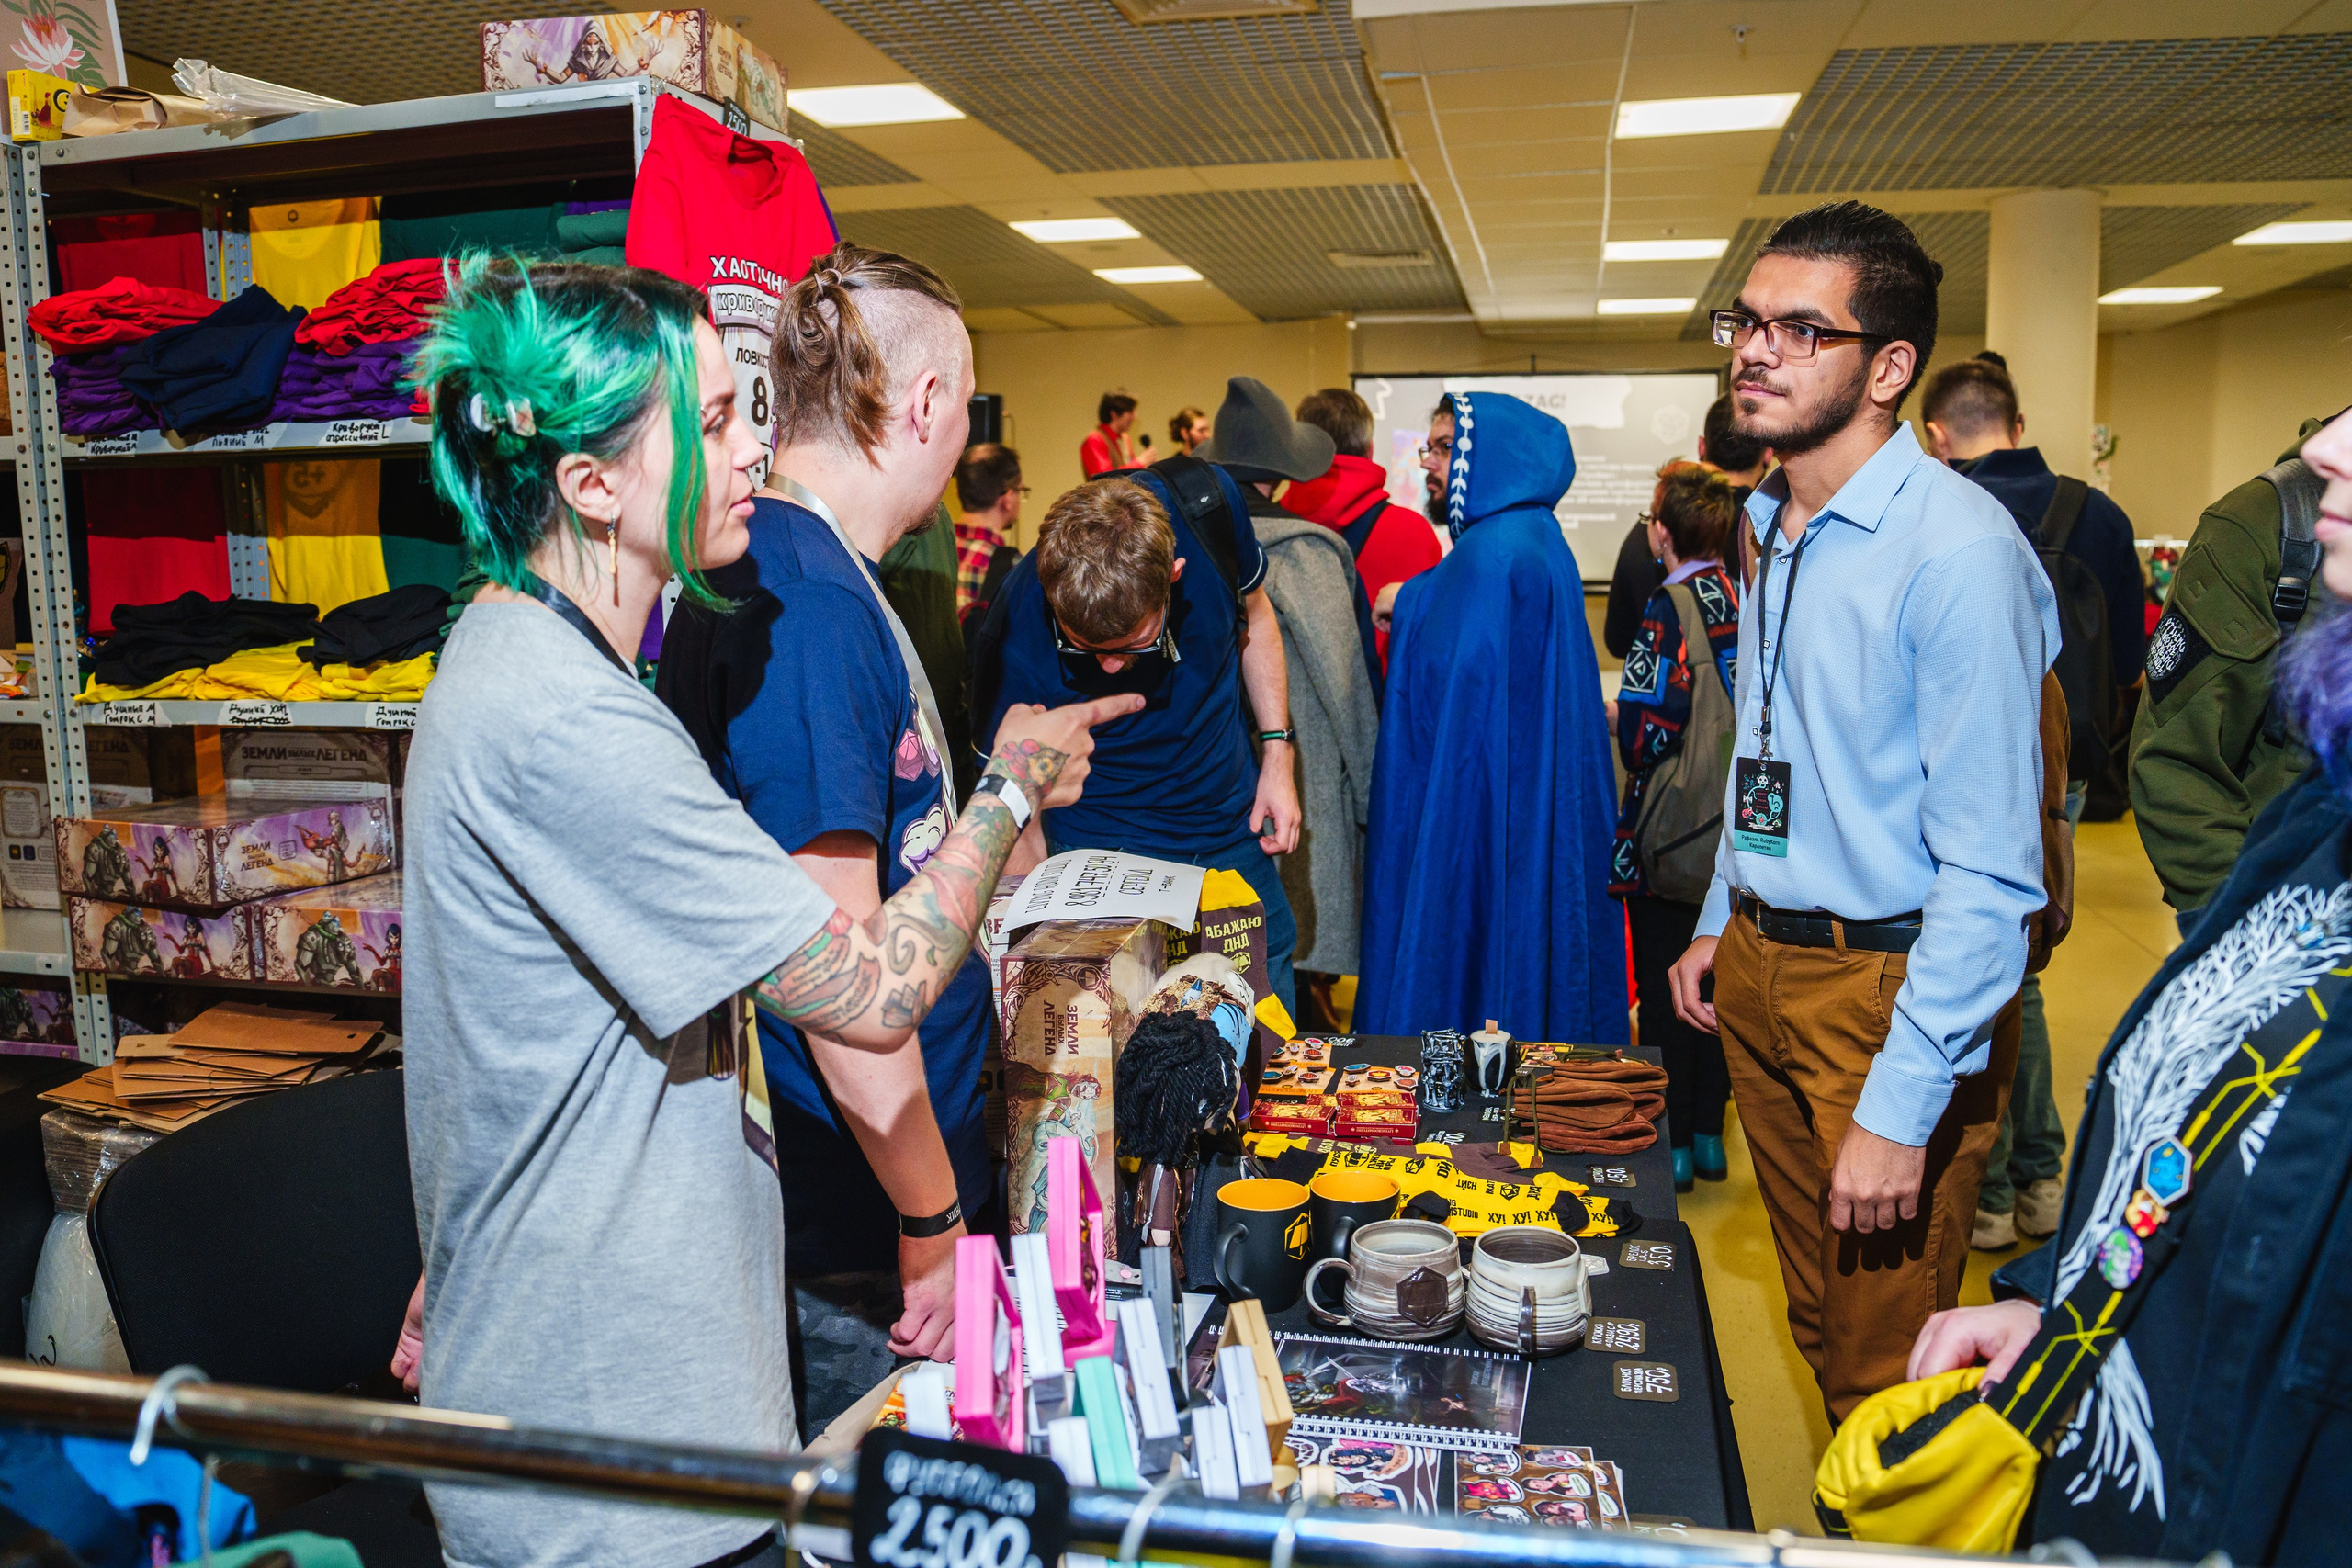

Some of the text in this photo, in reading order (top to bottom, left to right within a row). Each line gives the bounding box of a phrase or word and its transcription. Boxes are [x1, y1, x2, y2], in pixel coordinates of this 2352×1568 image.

[242, 746, 287, 760] ЗЕМЛИ
[316, 748, 368, 761] ЛЕГЕНД
[241, 840, 271, 855] ЗЕМЛИ
[240, 857, 275, 872] ЛЕГЕНД
[1205, 916, 1261, 939] АБАЖАЮ
[1223, 932, 1250, 954] ДНД
[1044, 999, 1057, 1058] ЛЕГЕНД
[1067, 1004, 1080, 1055] ЗЕМЛИ
